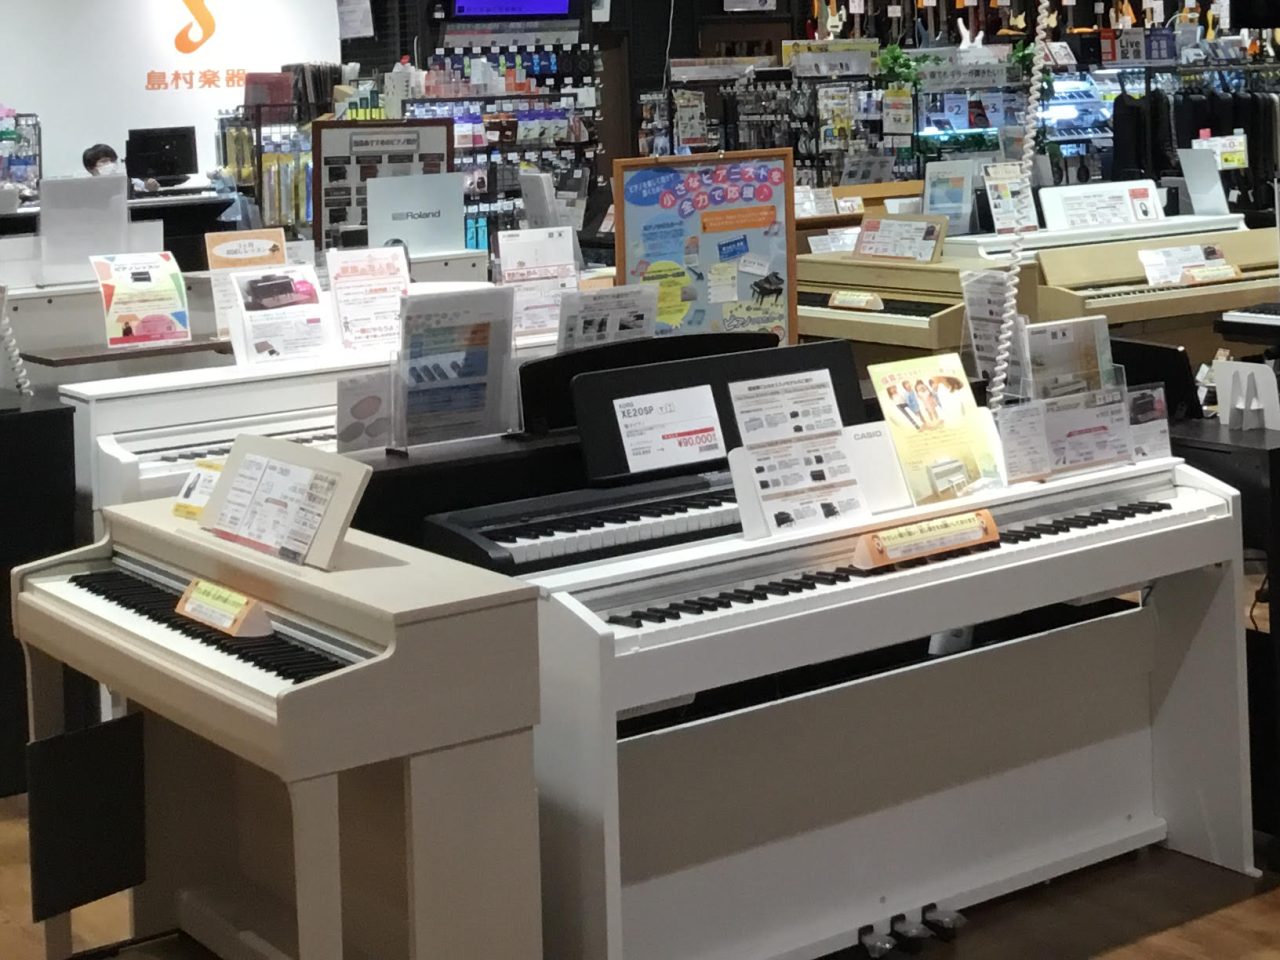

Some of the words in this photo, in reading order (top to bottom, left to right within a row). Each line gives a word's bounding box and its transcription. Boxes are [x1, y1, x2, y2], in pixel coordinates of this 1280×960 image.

[1120, 40, 1140, 49] Live
[1121, 49, 1141, 60] 配信
[145, 69, 246, 91] 島村楽器
[661, 167, 782, 208] 小さなピアニストを
[406, 209, 441, 220] Roland
[621, 405, 654, 419] XE20SP
[853, 430, 882, 441] CASIO
